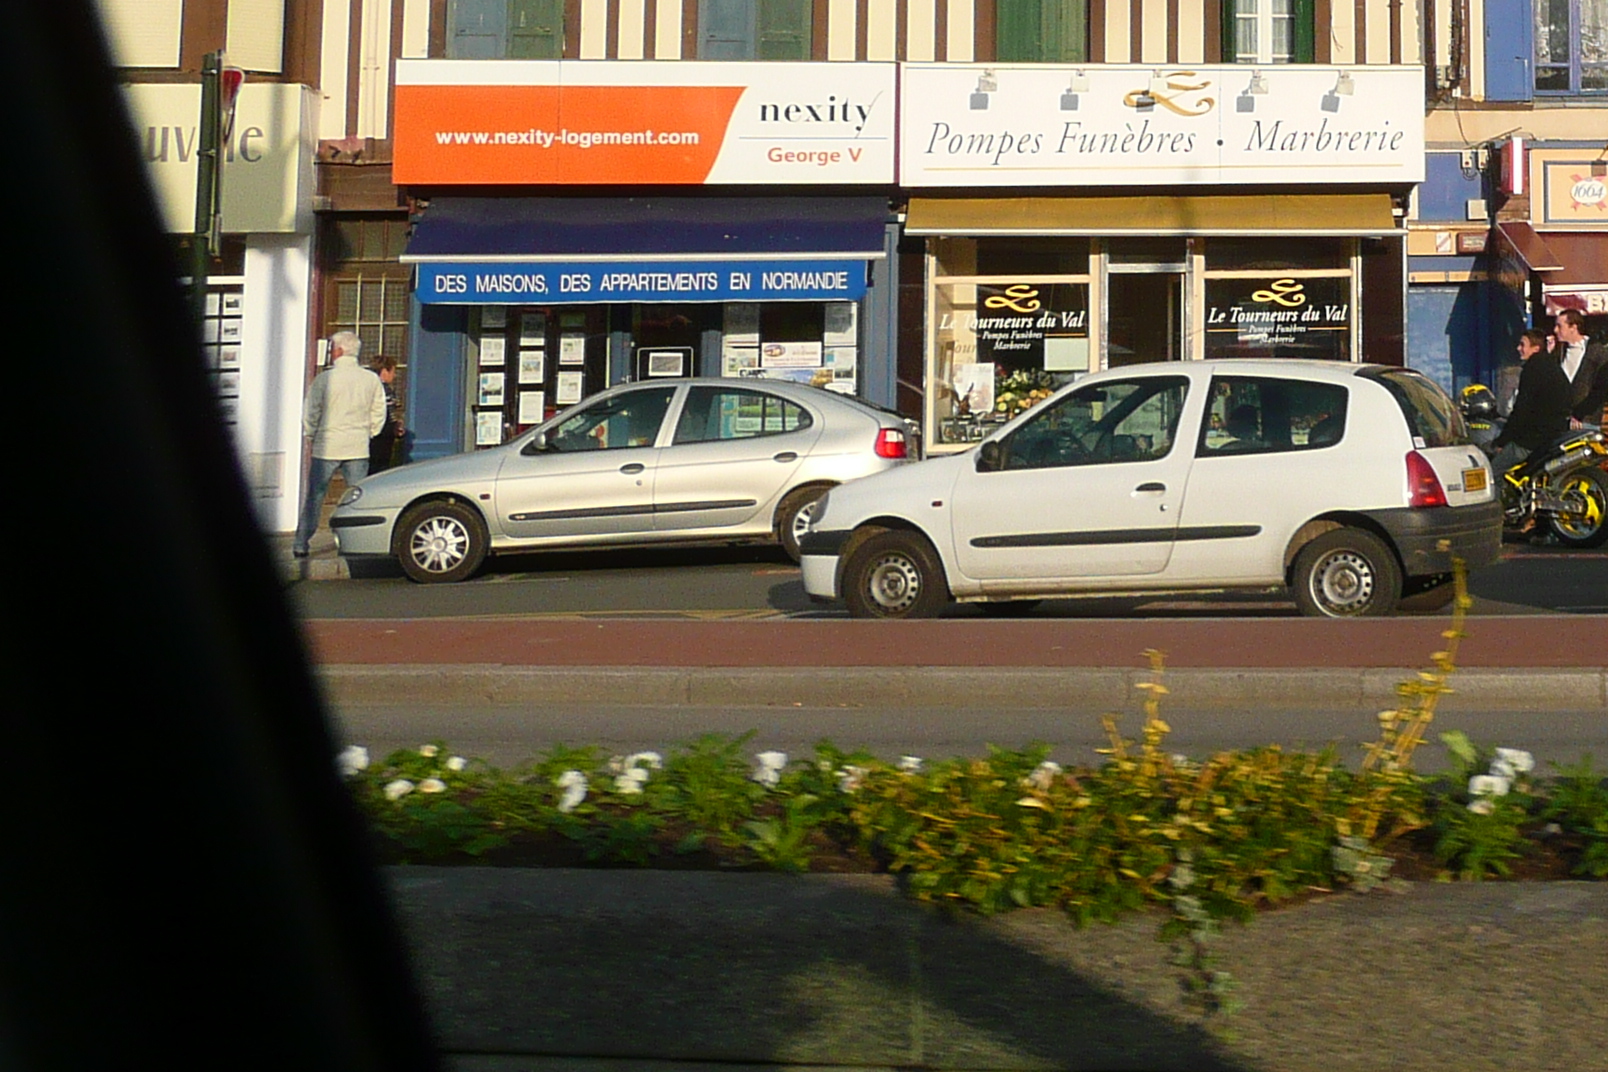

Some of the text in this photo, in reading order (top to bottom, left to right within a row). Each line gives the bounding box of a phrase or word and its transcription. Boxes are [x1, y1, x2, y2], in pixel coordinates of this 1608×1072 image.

[759, 89, 884, 139] nexity
[435, 128, 699, 149] www.nexity-logement.com
[923, 117, 1405, 166] Pompes Funèbres Marbrerie
[767, 146, 863, 166] George V
[434, 270, 849, 295] DES MAISONS, DES APPARTEMENTS EN NORMANDIE
[1036, 311, 1058, 329] du
[1060, 310, 1087, 328] Val
[1207, 303, 1349, 324] Le Tourneurs du Val
